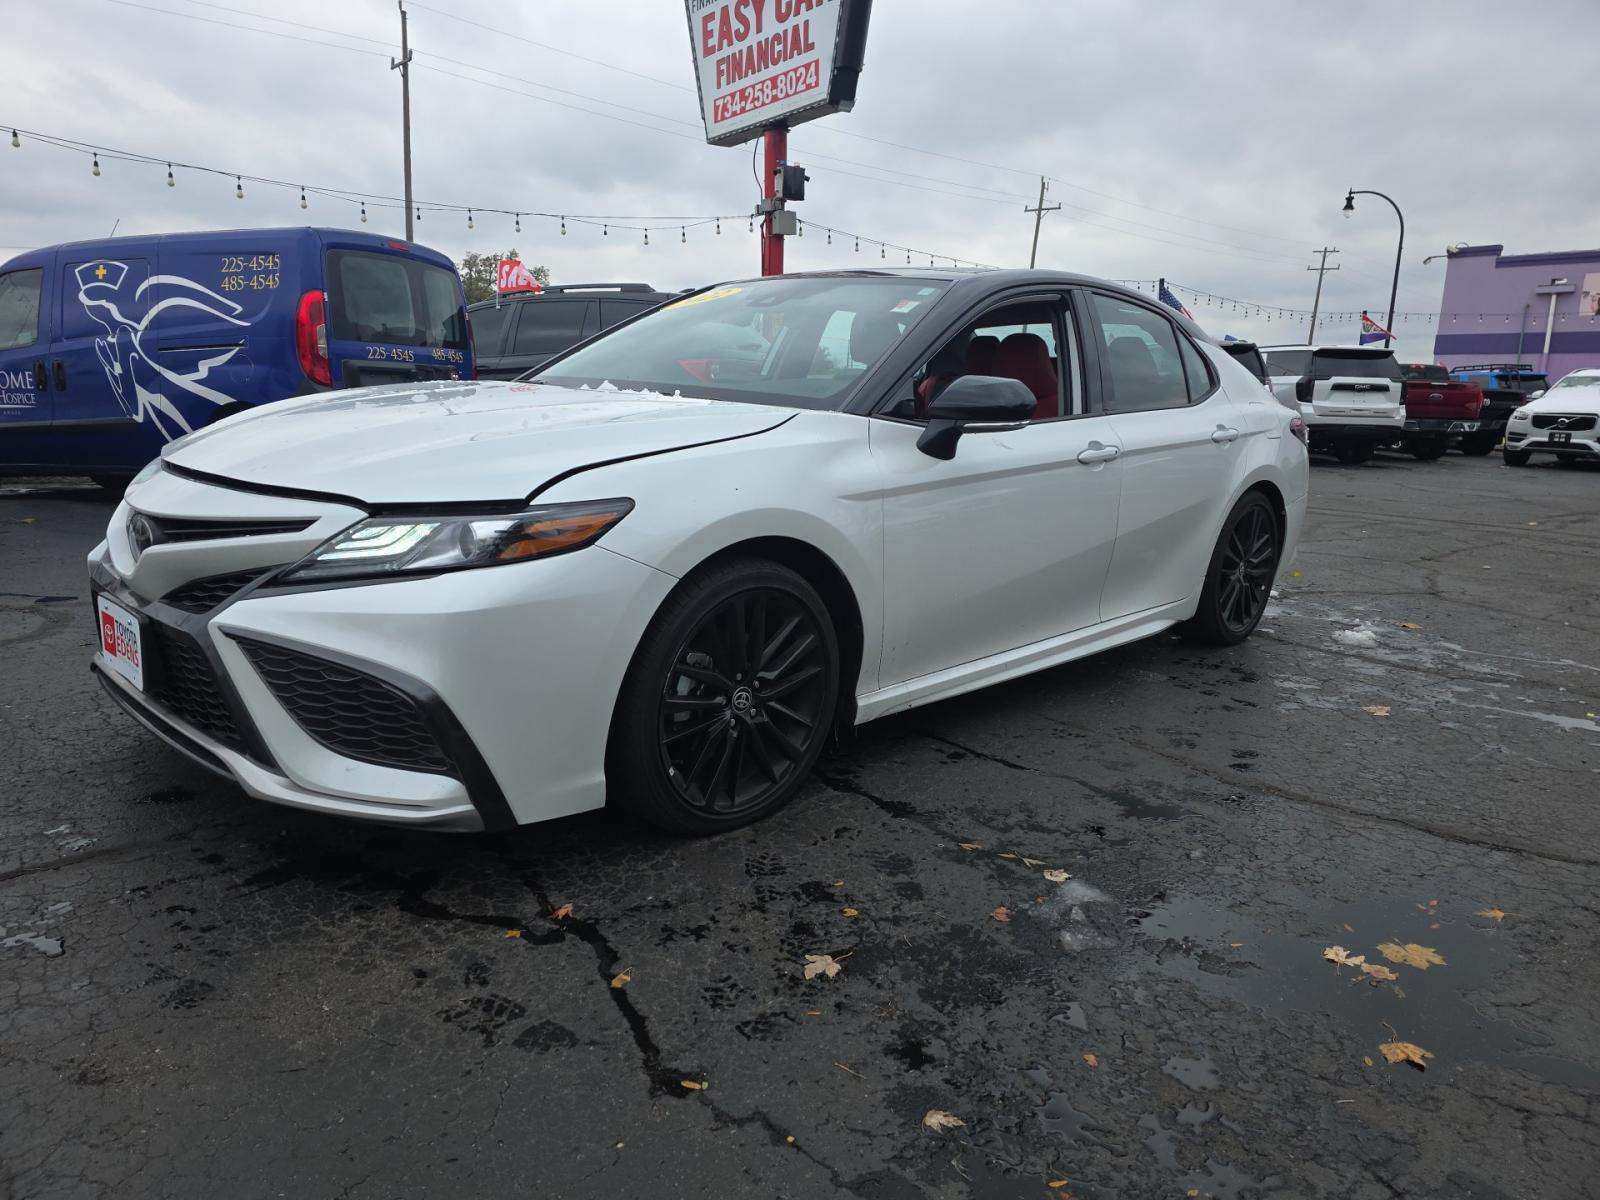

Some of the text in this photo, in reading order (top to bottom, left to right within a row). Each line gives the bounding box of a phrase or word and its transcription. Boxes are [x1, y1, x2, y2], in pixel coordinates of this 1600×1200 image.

[702, 0, 766, 58] EASY
[716, 19, 815, 90] FINANCIAL
[716, 62, 817, 121] 734-258-8024
[221, 254, 281, 272] 225-4545
[221, 273, 281, 291] 485-4545
[366, 346, 464, 363] 225-4545 485-4545
